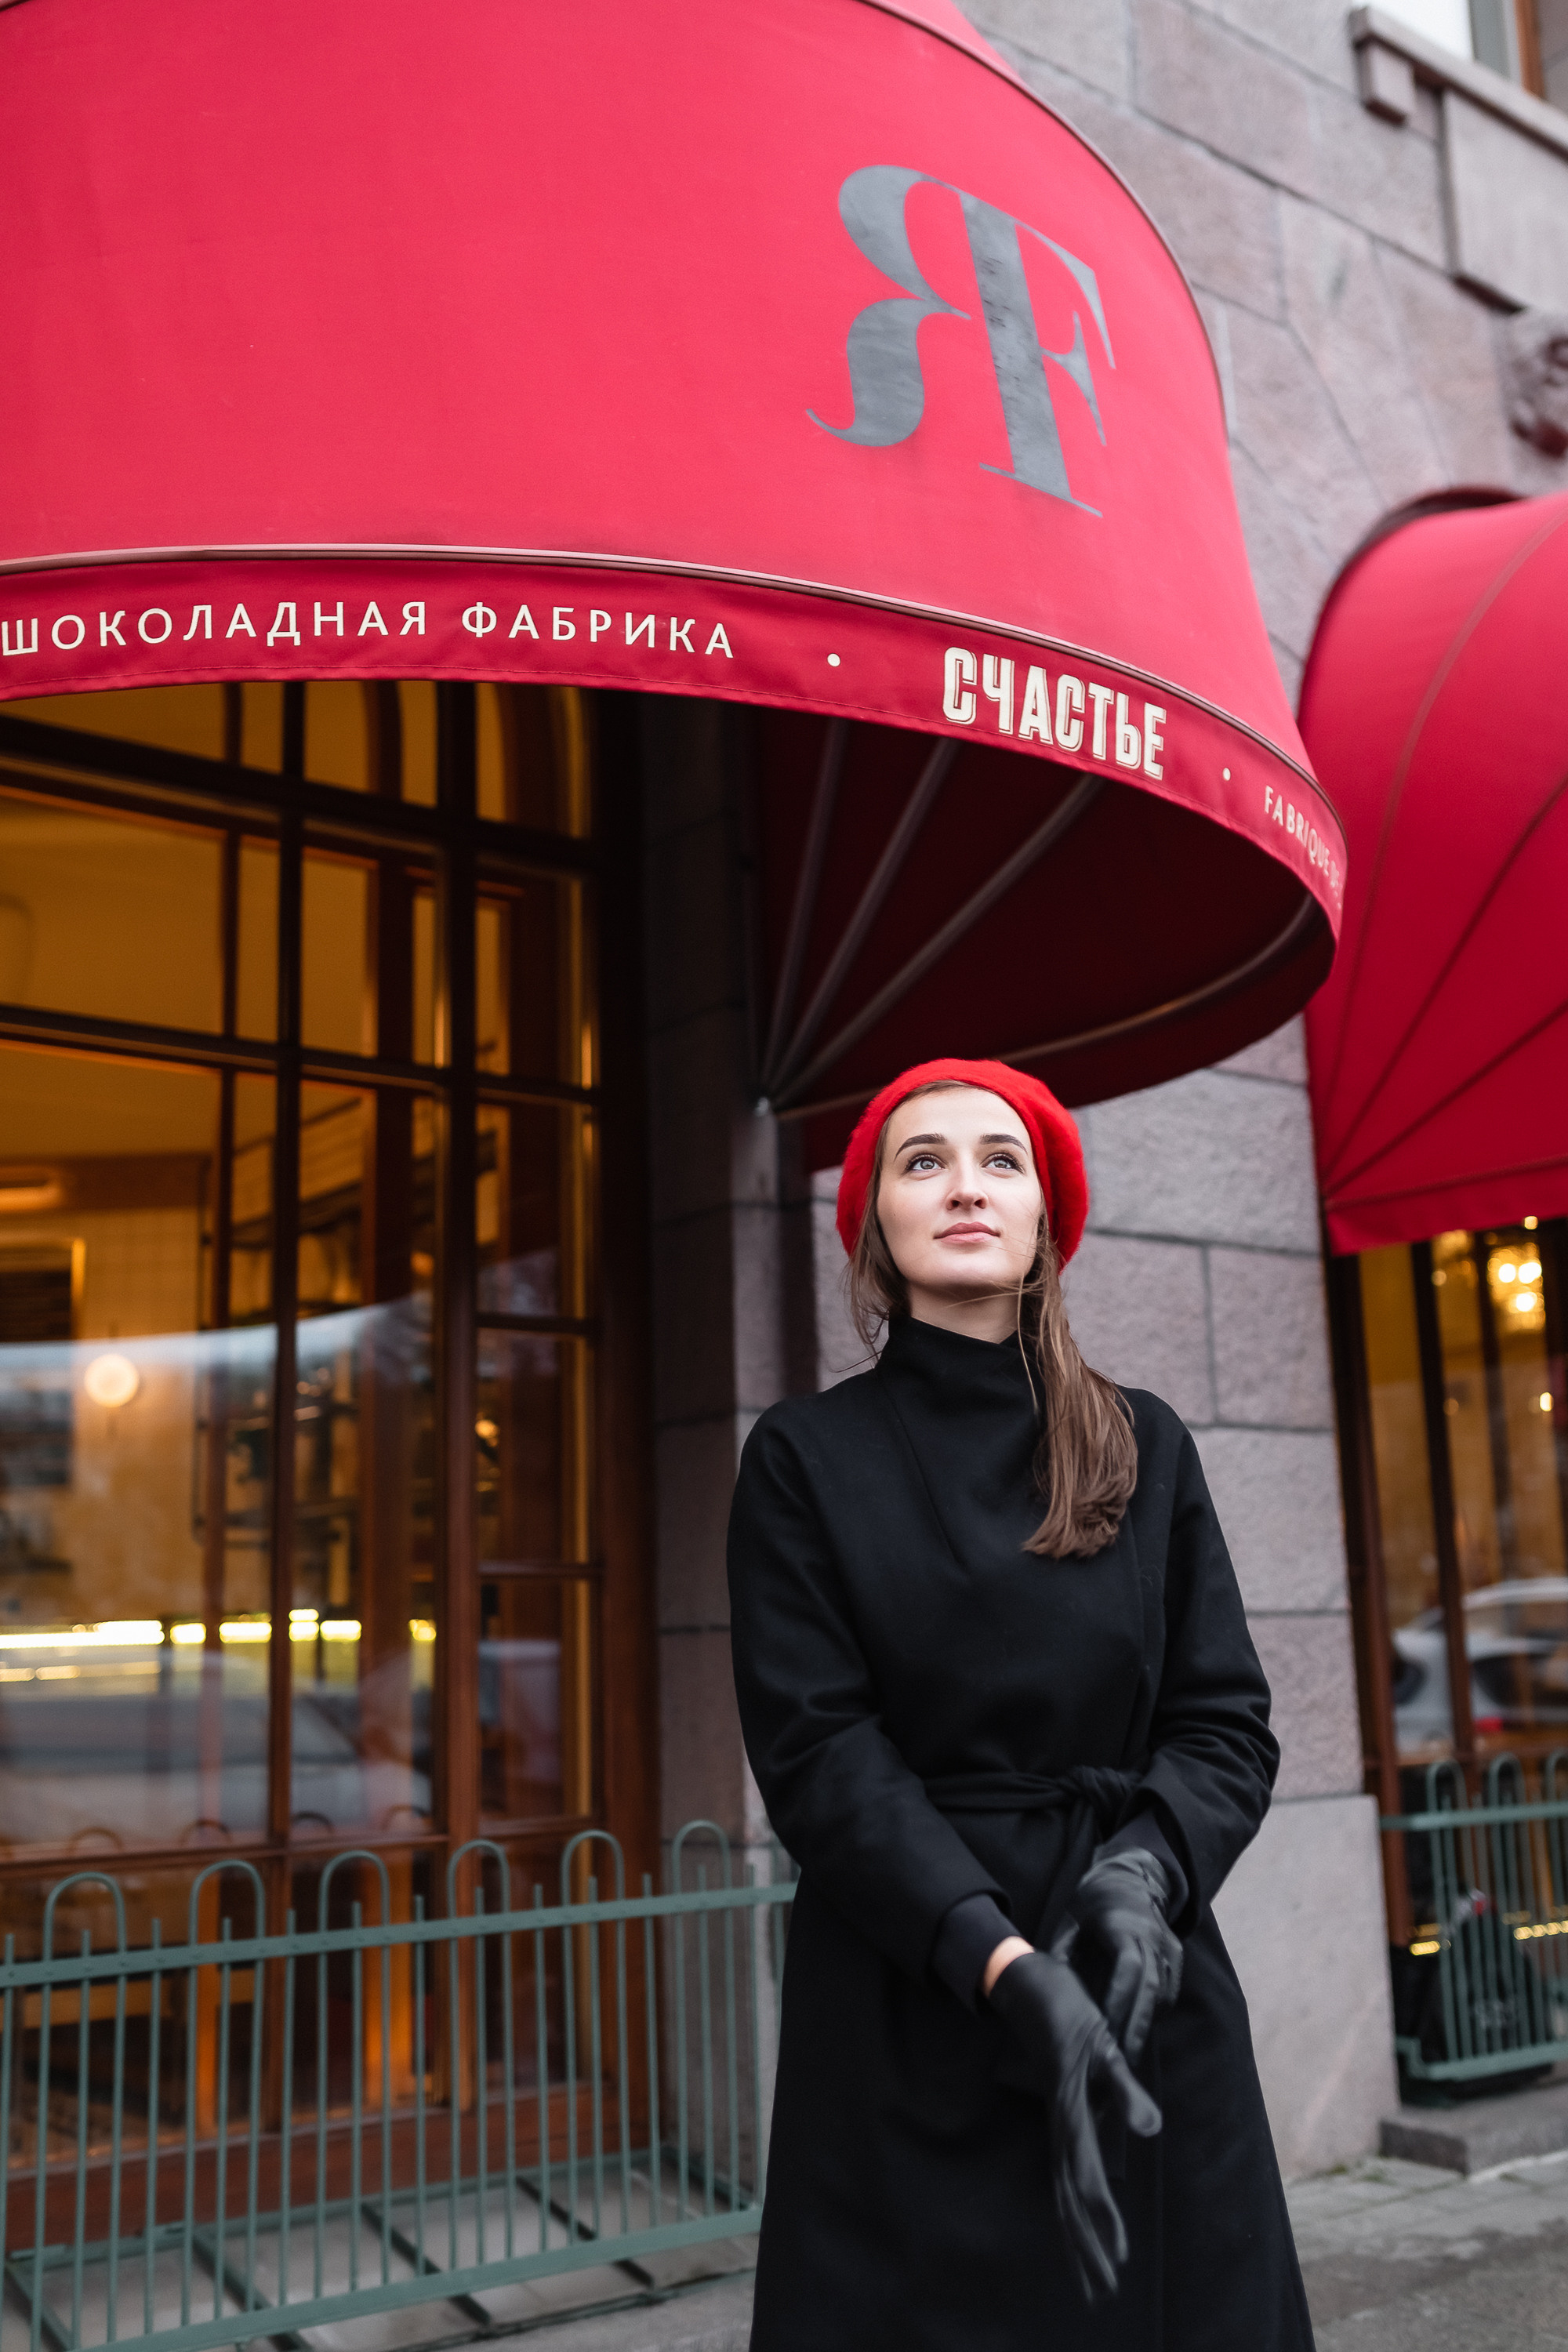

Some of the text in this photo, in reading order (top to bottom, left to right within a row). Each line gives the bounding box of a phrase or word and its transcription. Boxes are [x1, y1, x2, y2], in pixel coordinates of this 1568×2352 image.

[1, 601, 734, 659] ШОКОЛАДНАЯ ФАБРИКА
[942, 647, 1167, 780] СЧАСТЬЕ
[1264, 785, 1330, 877] FABRIQUE
